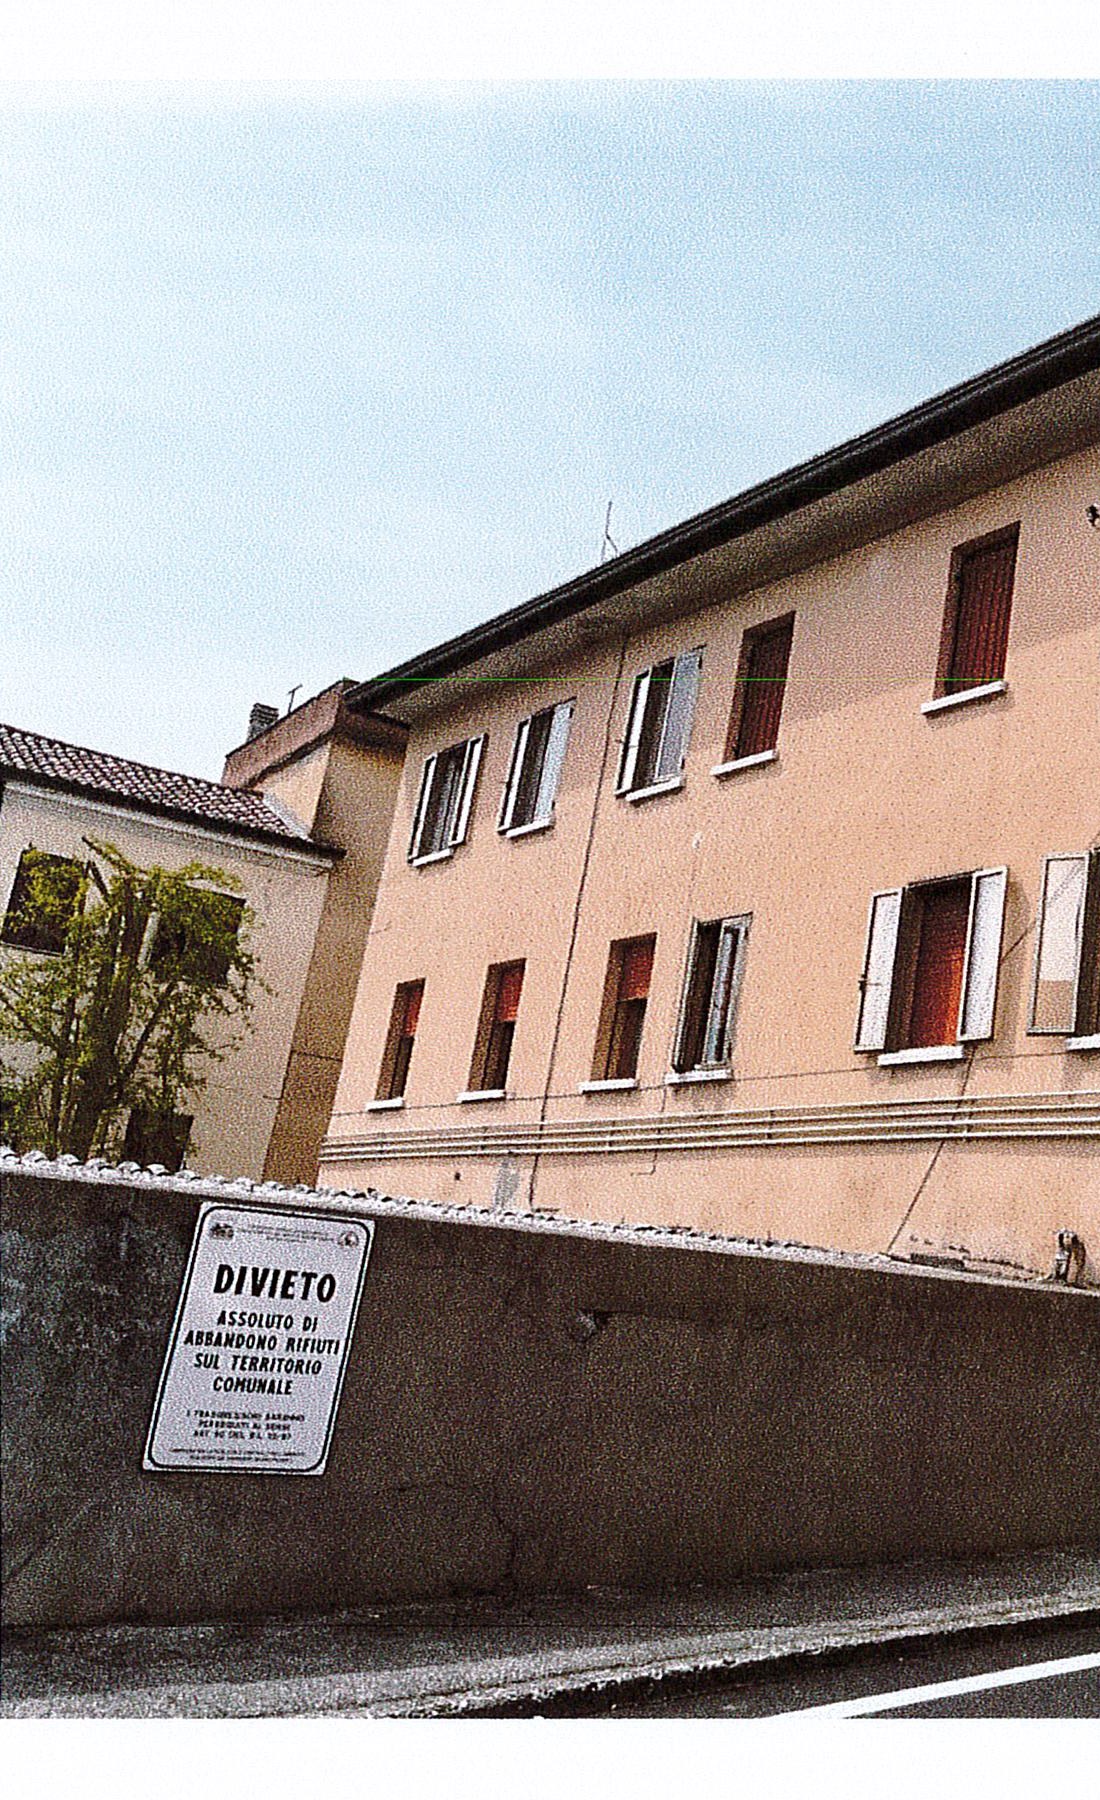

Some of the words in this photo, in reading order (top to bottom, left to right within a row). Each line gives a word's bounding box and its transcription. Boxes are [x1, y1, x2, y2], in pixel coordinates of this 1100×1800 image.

[213, 1263, 337, 1303] DIVIETO
[217, 1310, 294, 1329] ASSOLUTO
[302, 1316, 319, 1332] DI
[183, 1330, 278, 1351] ABBANDONO
[285, 1338, 340, 1355] RIFIUTI
[194, 1353, 220, 1369] SUL
[232, 1355, 322, 1374] TERRITORIO
[213, 1377, 293, 1395] COMUNALE
